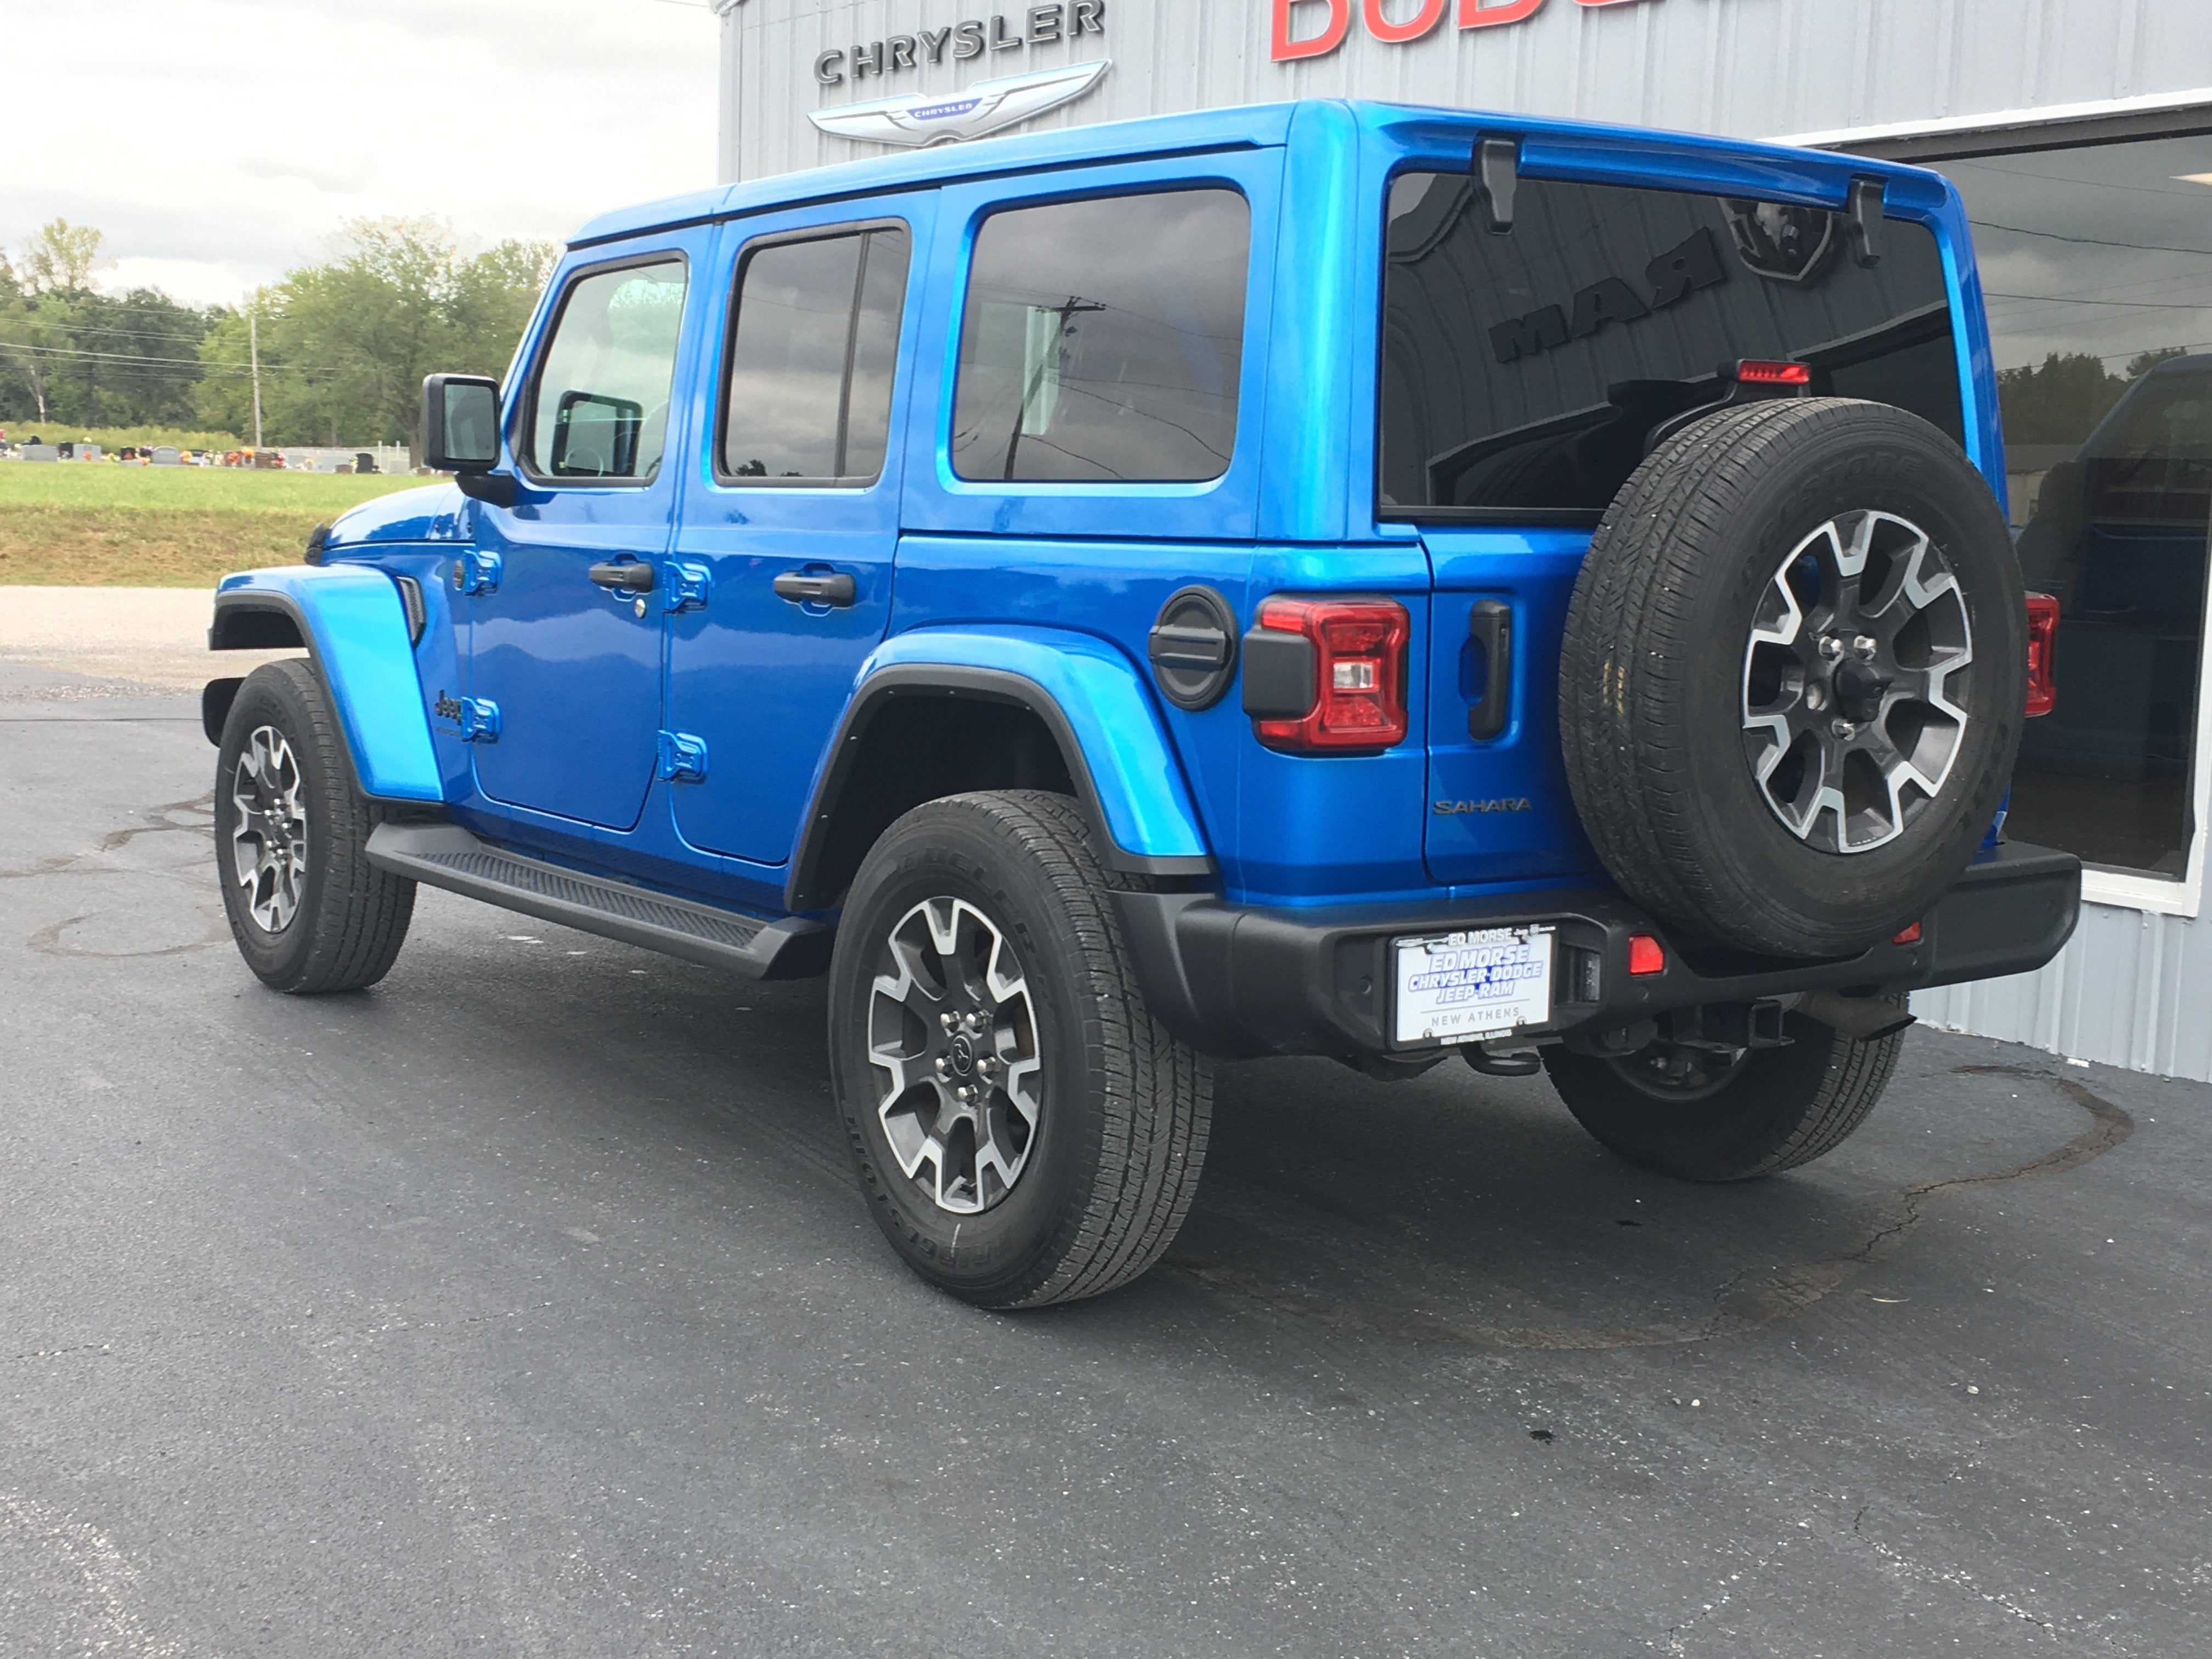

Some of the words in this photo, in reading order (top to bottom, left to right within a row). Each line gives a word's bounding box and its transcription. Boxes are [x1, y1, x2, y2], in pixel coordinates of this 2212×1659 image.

[814, 0, 1104, 84] CHRYSLER
[914, 103, 974, 117] CHRYSLER
[1434, 798, 1531, 815] SAHARA
[1448, 933, 1466, 946] ED
[1468, 928, 1513, 944] MORSE
[1430, 952, 1457, 972] ED
[1458, 944, 1530, 969] MORSE
[1431, 1014, 1462, 1026] NEW
[1468, 1007, 1520, 1022] ATHENS
